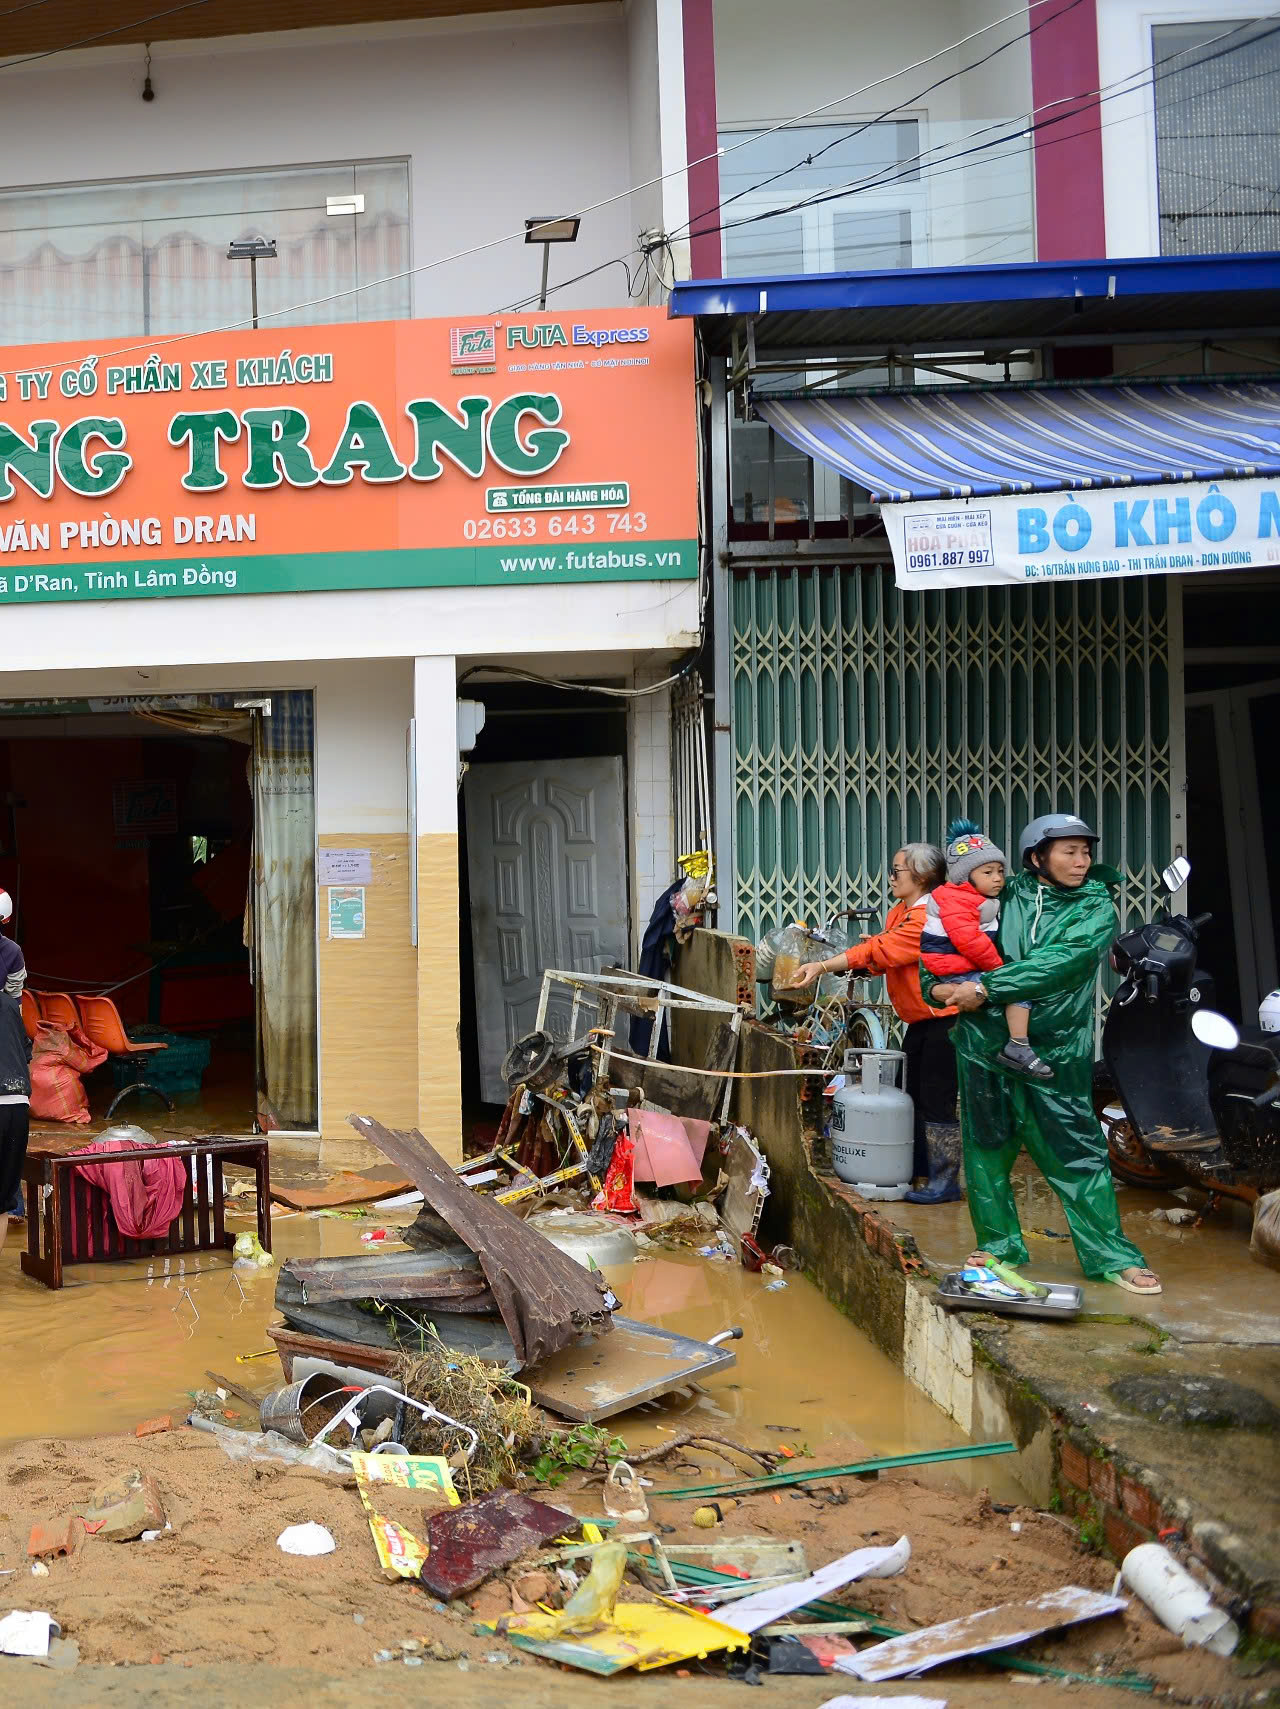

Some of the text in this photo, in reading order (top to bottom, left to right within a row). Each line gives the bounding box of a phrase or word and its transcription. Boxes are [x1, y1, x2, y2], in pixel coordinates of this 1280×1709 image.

[506, 324, 649, 349] FUTA Express
[17, 369, 52, 400] TY
[60, 355, 99, 396] CỔ
[106, 353, 181, 394] PHẦN
[190, 360, 228, 390] XE
[236, 352, 334, 388] KHÁCH
[168, 391, 570, 492] TRANG
[512, 487, 624, 505] TỔNG ĐÀI HÀNG HÓA
[60, 511, 164, 549] PHÒNG
[174, 513, 257, 545] DRAN
[463, 512, 648, 540] 02633 643 743
[1017, 493, 1093, 555] BÒ
[1114, 484, 1238, 549] KHÔ
[500, 551, 682, 572] www.futabus.vn
[910, 549, 990, 568] 0961.887 997
[1025, 565, 1040, 577] ĐC:
[1077, 559, 1102, 574] HƯNG
[1102, 559, 1120, 574] ĐẠO
[1127, 557, 1142, 573] THỊ
[1169, 554, 1194, 568] DRAN
[1201, 552, 1220, 566] ĐƠN
[1221, 551, 1252, 565] DƯƠNG
[84, 571, 128, 589] Tỉnh
[134, 570, 176, 587] Lâm
[182, 564, 237, 588] Đồng
